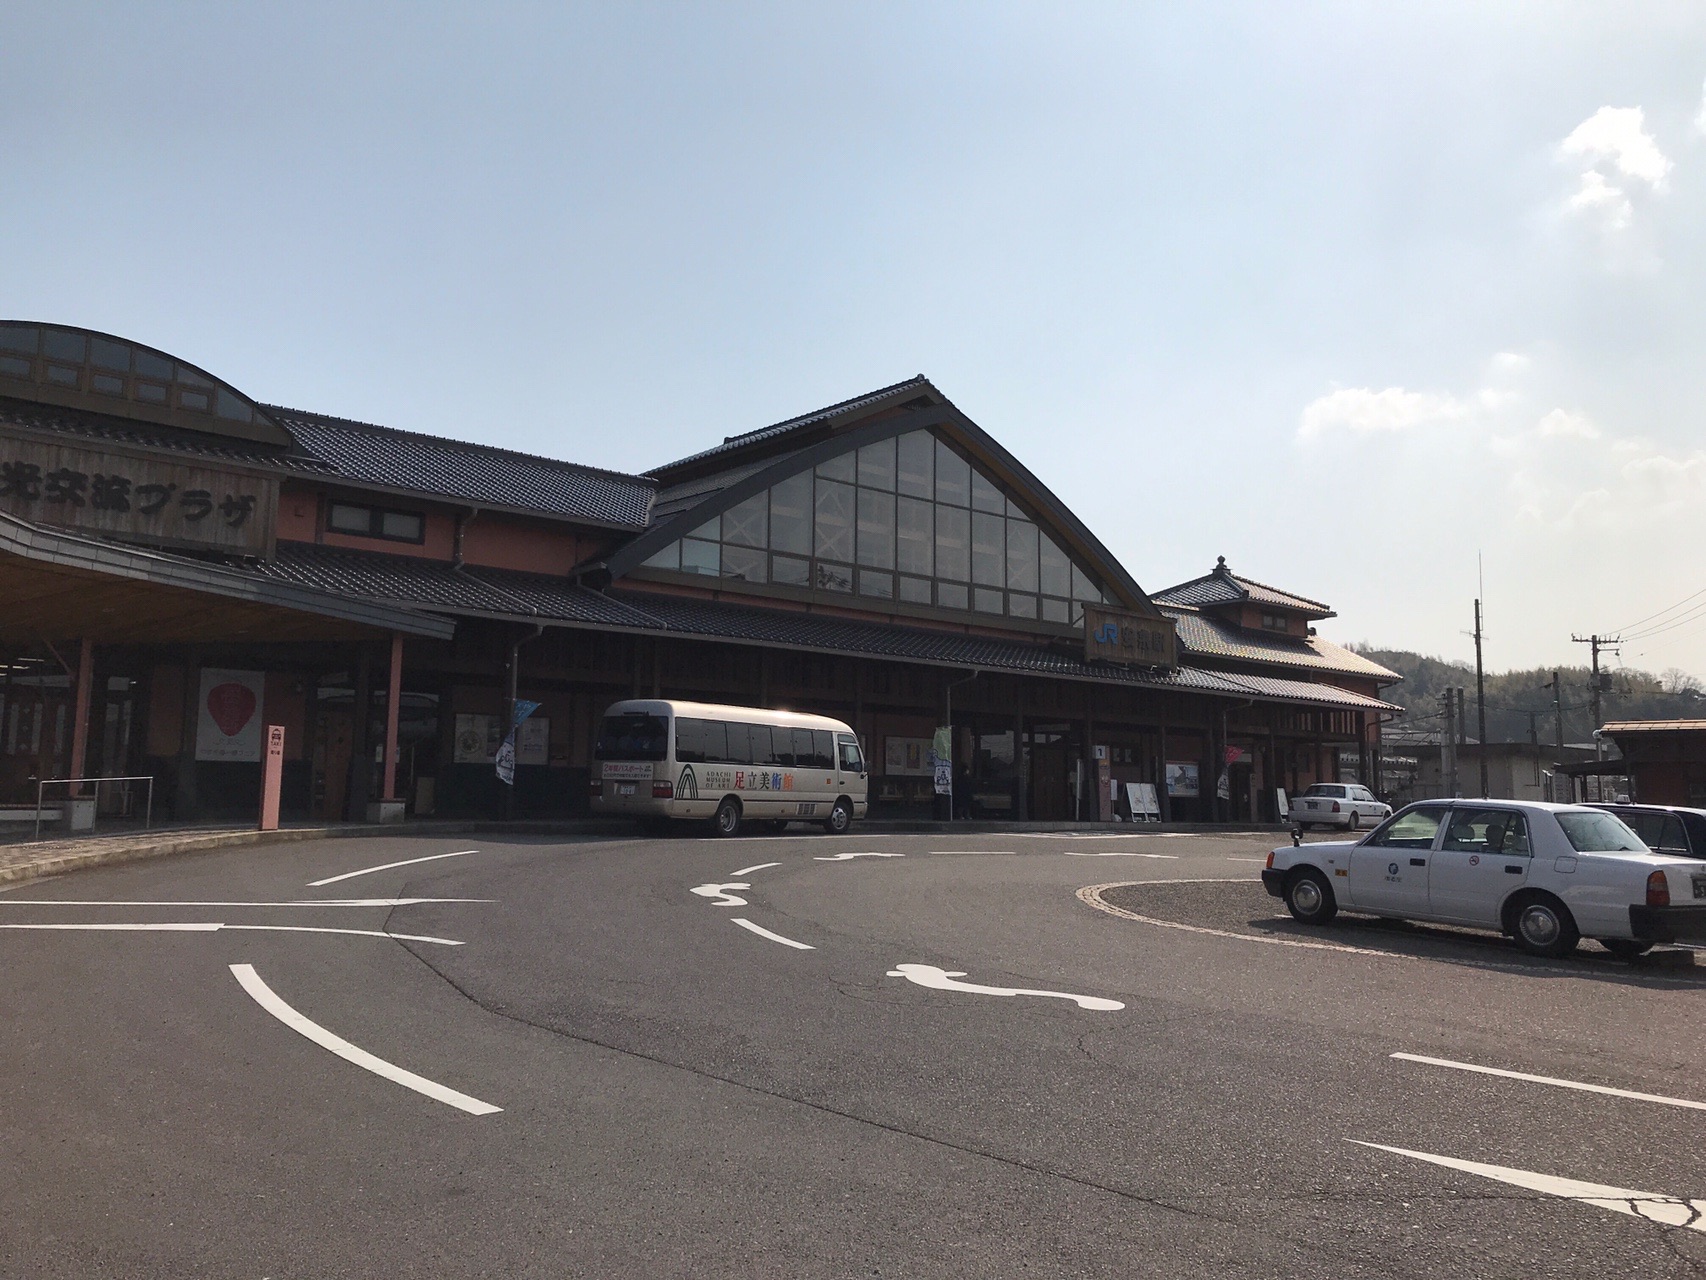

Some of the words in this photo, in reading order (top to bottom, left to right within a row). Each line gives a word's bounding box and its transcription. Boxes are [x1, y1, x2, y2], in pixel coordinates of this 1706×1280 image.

[1093, 623, 1119, 646] JR
[733, 770, 794, 791] 足立美術館
